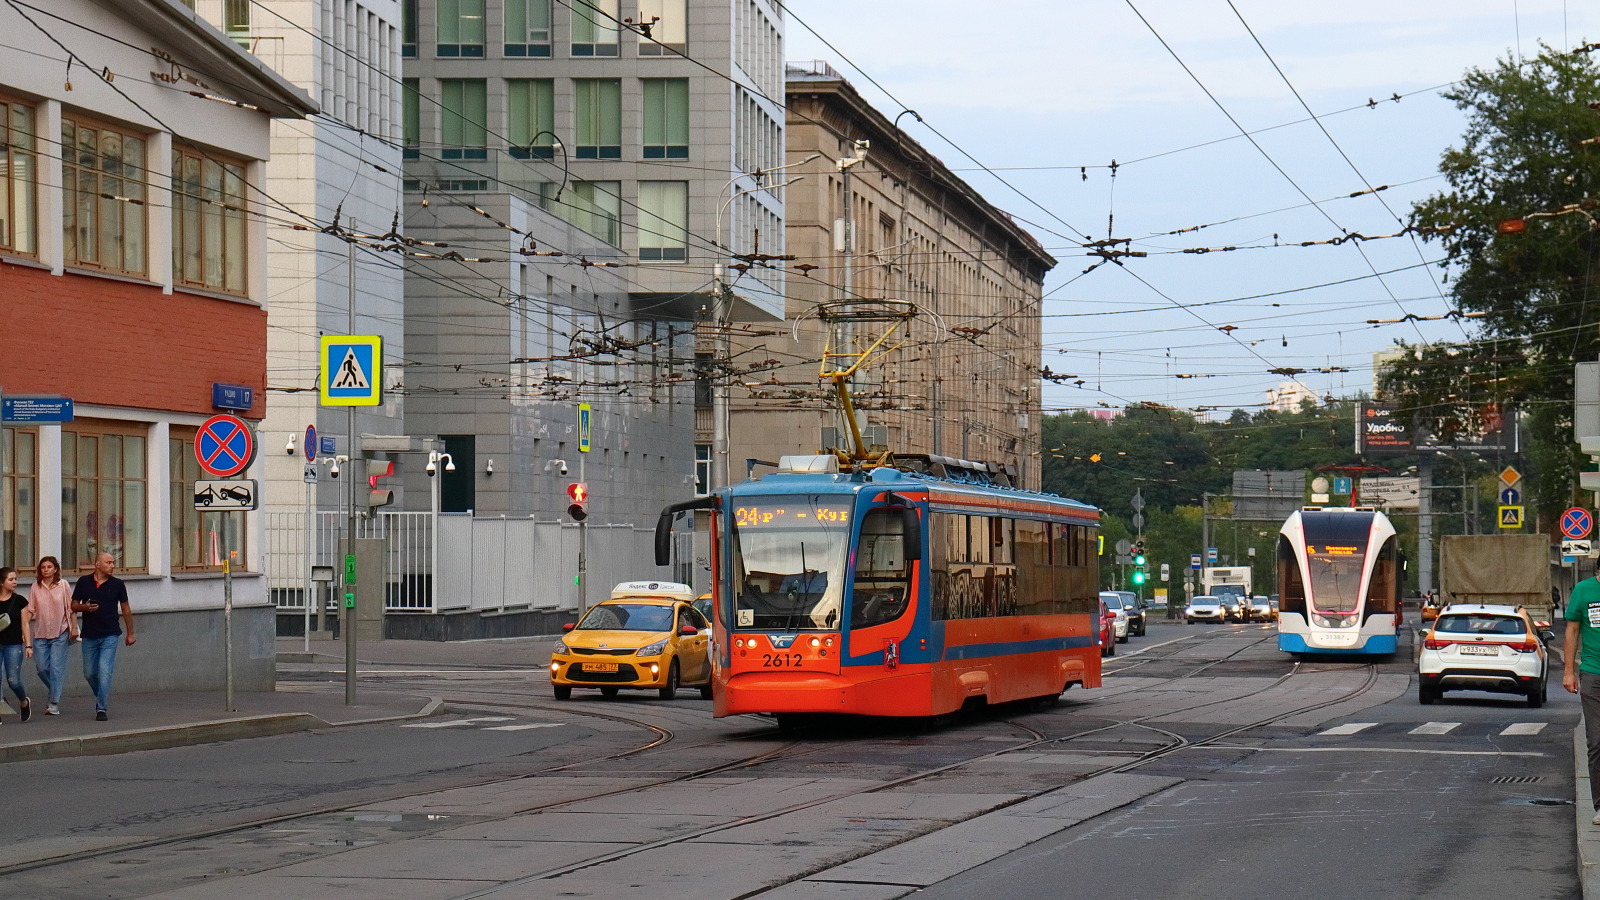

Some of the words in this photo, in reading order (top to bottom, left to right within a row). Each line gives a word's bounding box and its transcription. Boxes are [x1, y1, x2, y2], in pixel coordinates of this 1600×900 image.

[244, 391, 250, 403] 17
[1367, 423, 1405, 433] Удобно
[736, 507, 758, 526] 24
[762, 653, 803, 667] 2612
